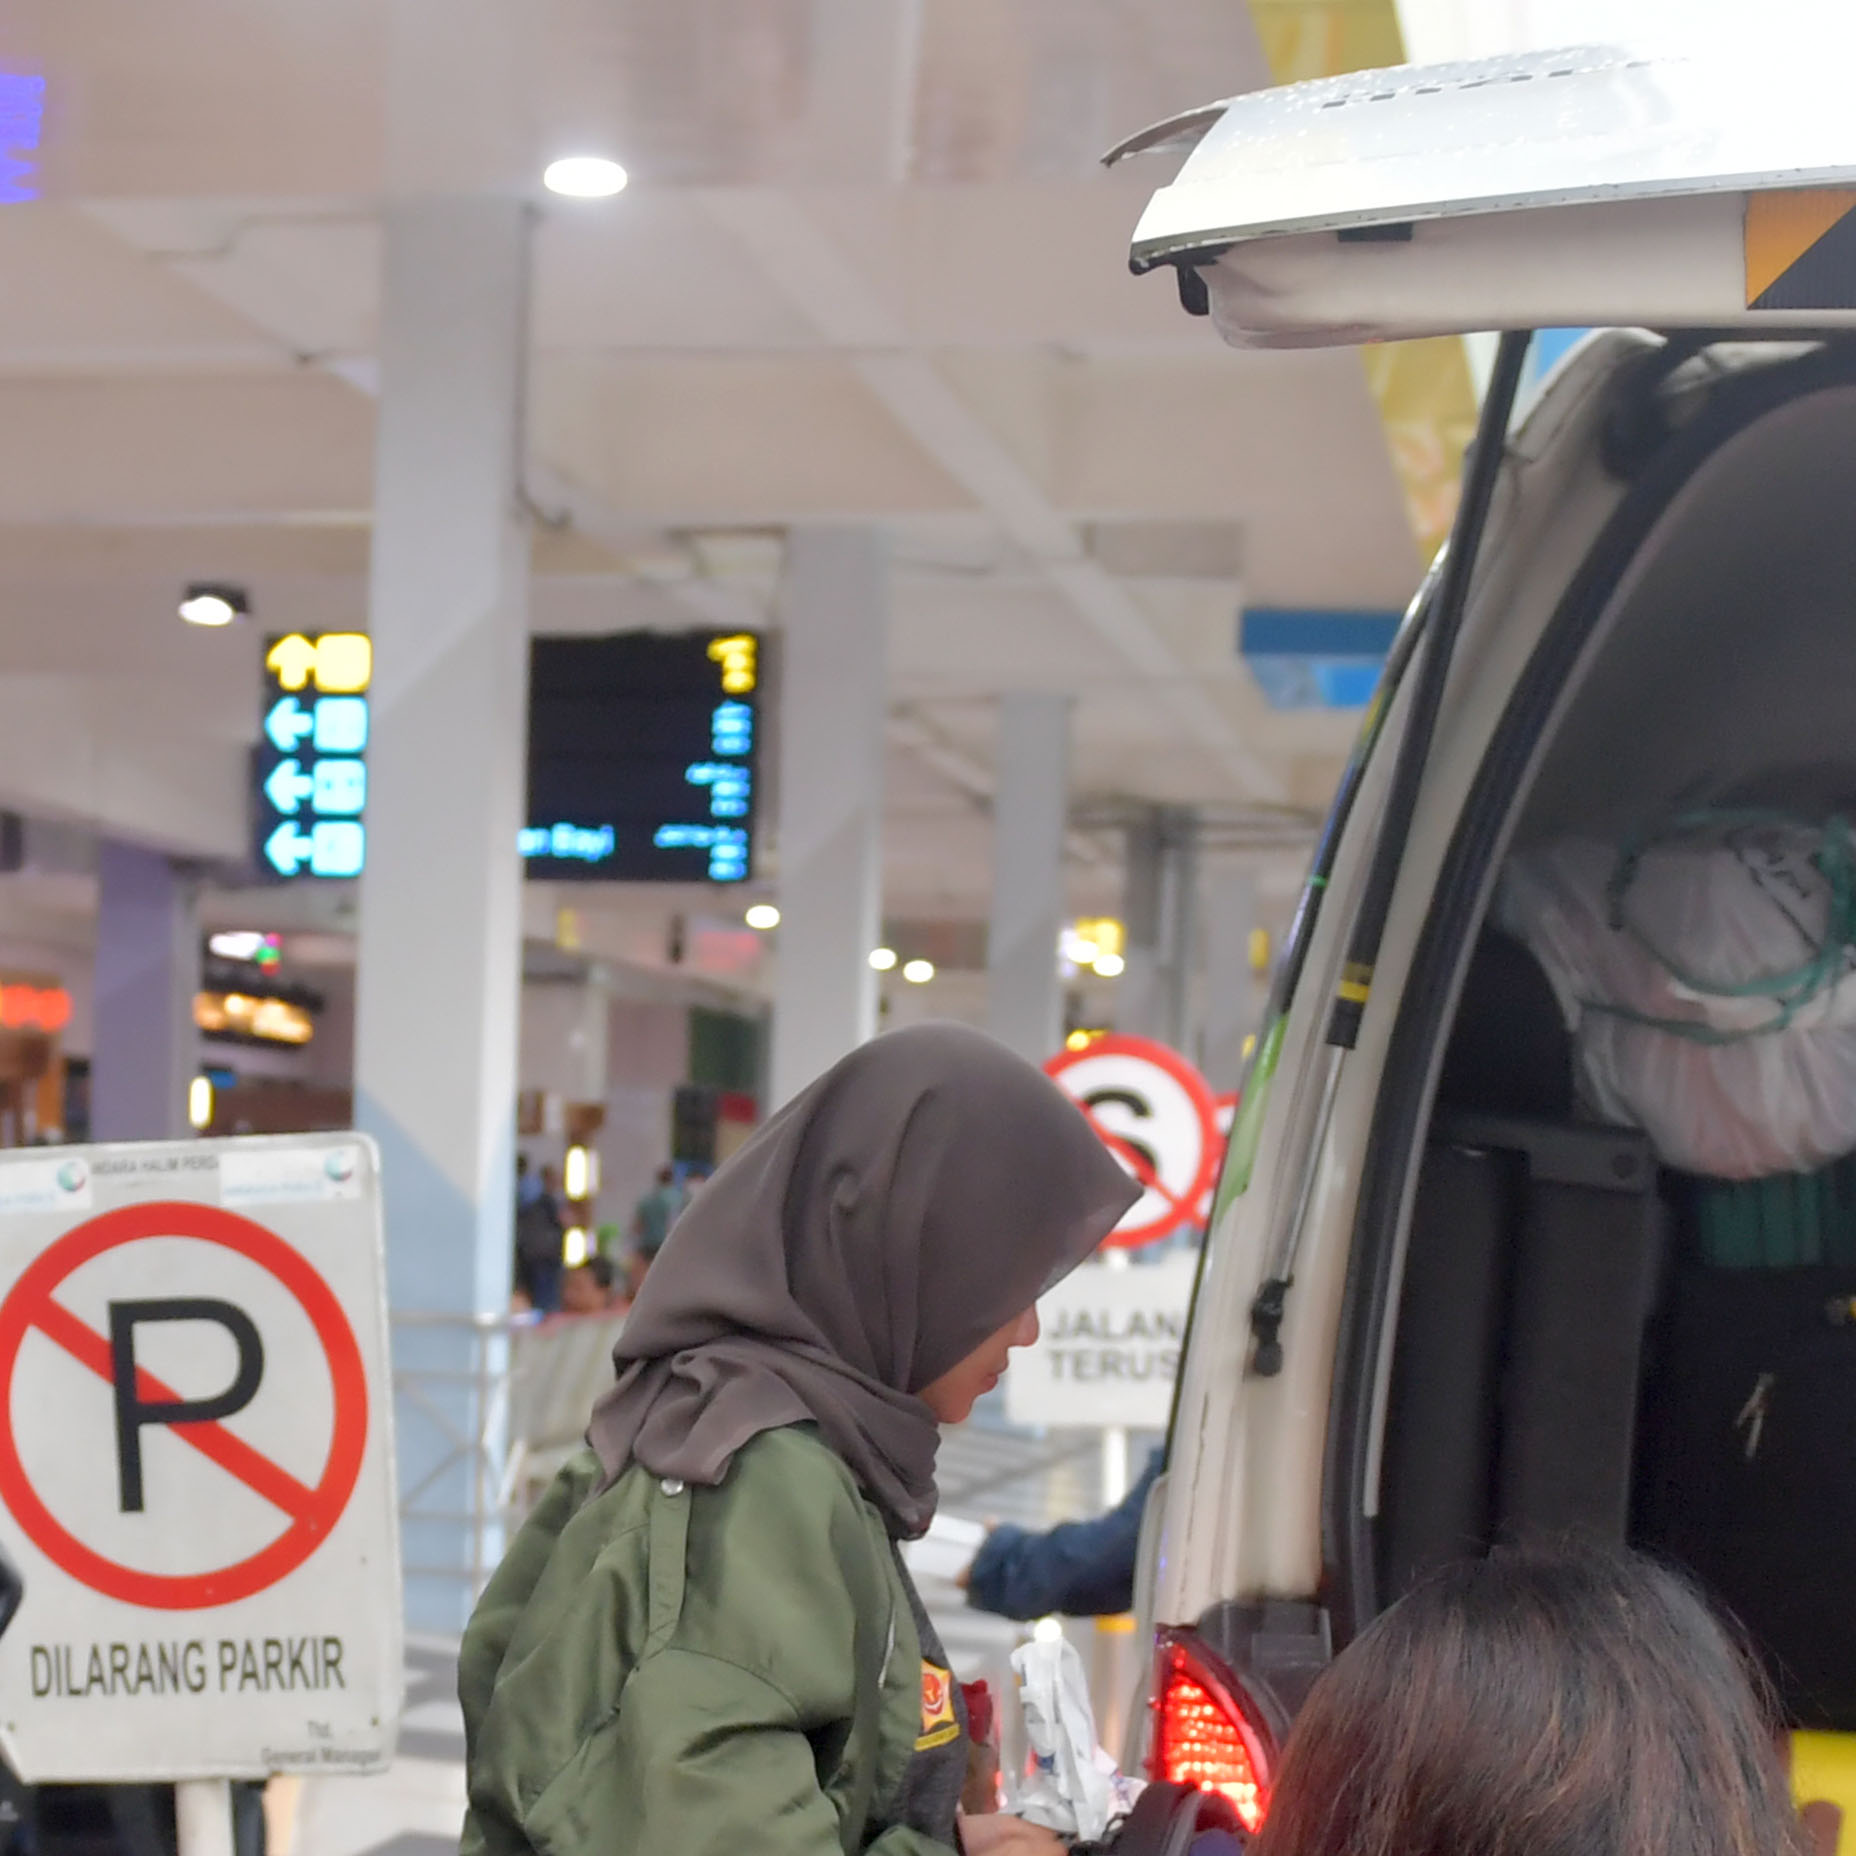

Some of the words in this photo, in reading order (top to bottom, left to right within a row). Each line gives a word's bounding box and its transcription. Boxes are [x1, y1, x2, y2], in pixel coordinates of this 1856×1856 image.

[1049, 1308, 1178, 1341] JALAN
[1049, 1347, 1176, 1382] TERUS
[107, 1296, 265, 1513] P
[30, 1640, 206, 1698] DILARANG
[217, 1635, 346, 1692] PARKIR
